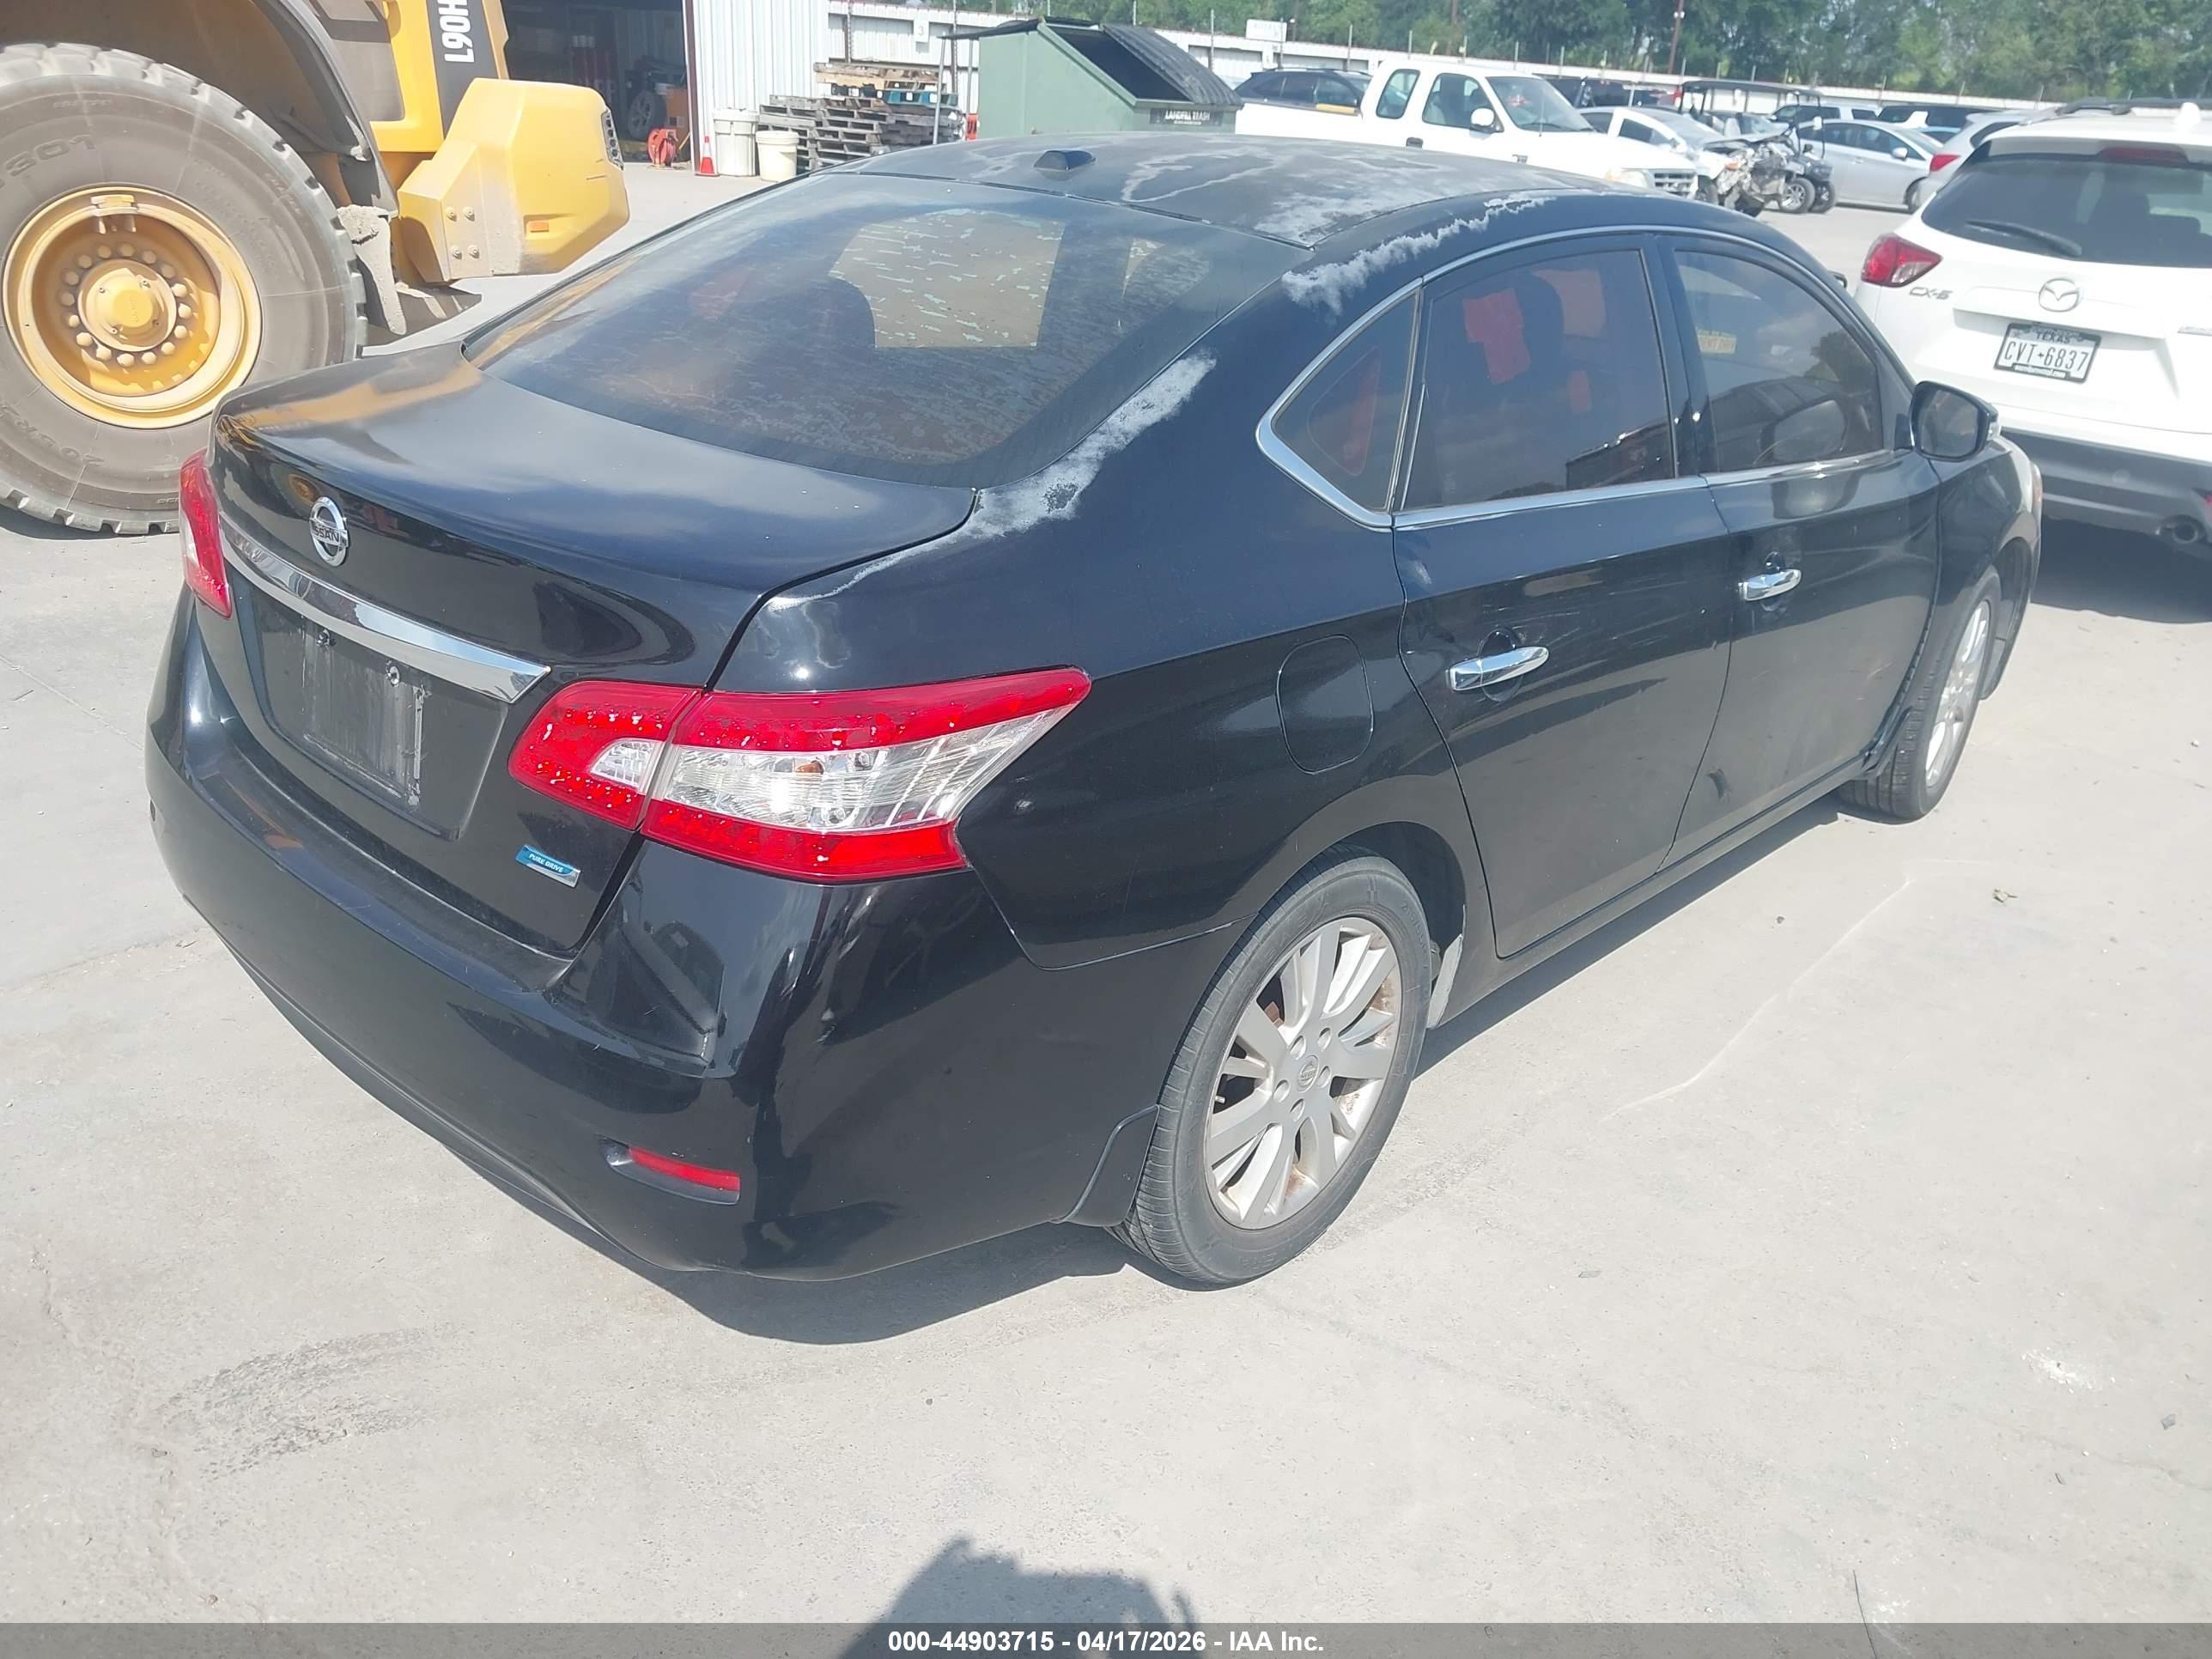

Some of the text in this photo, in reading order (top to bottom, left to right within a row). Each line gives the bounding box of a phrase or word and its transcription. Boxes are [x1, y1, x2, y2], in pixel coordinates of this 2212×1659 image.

[437, 0, 475, 63] L90H
[2004, 341, 2037, 363] CVT
[2044, 346, 2089, 372] 6837
[311, 520, 340, 543] SSAN
[529, 854, 564, 873] PURE DRIVE
